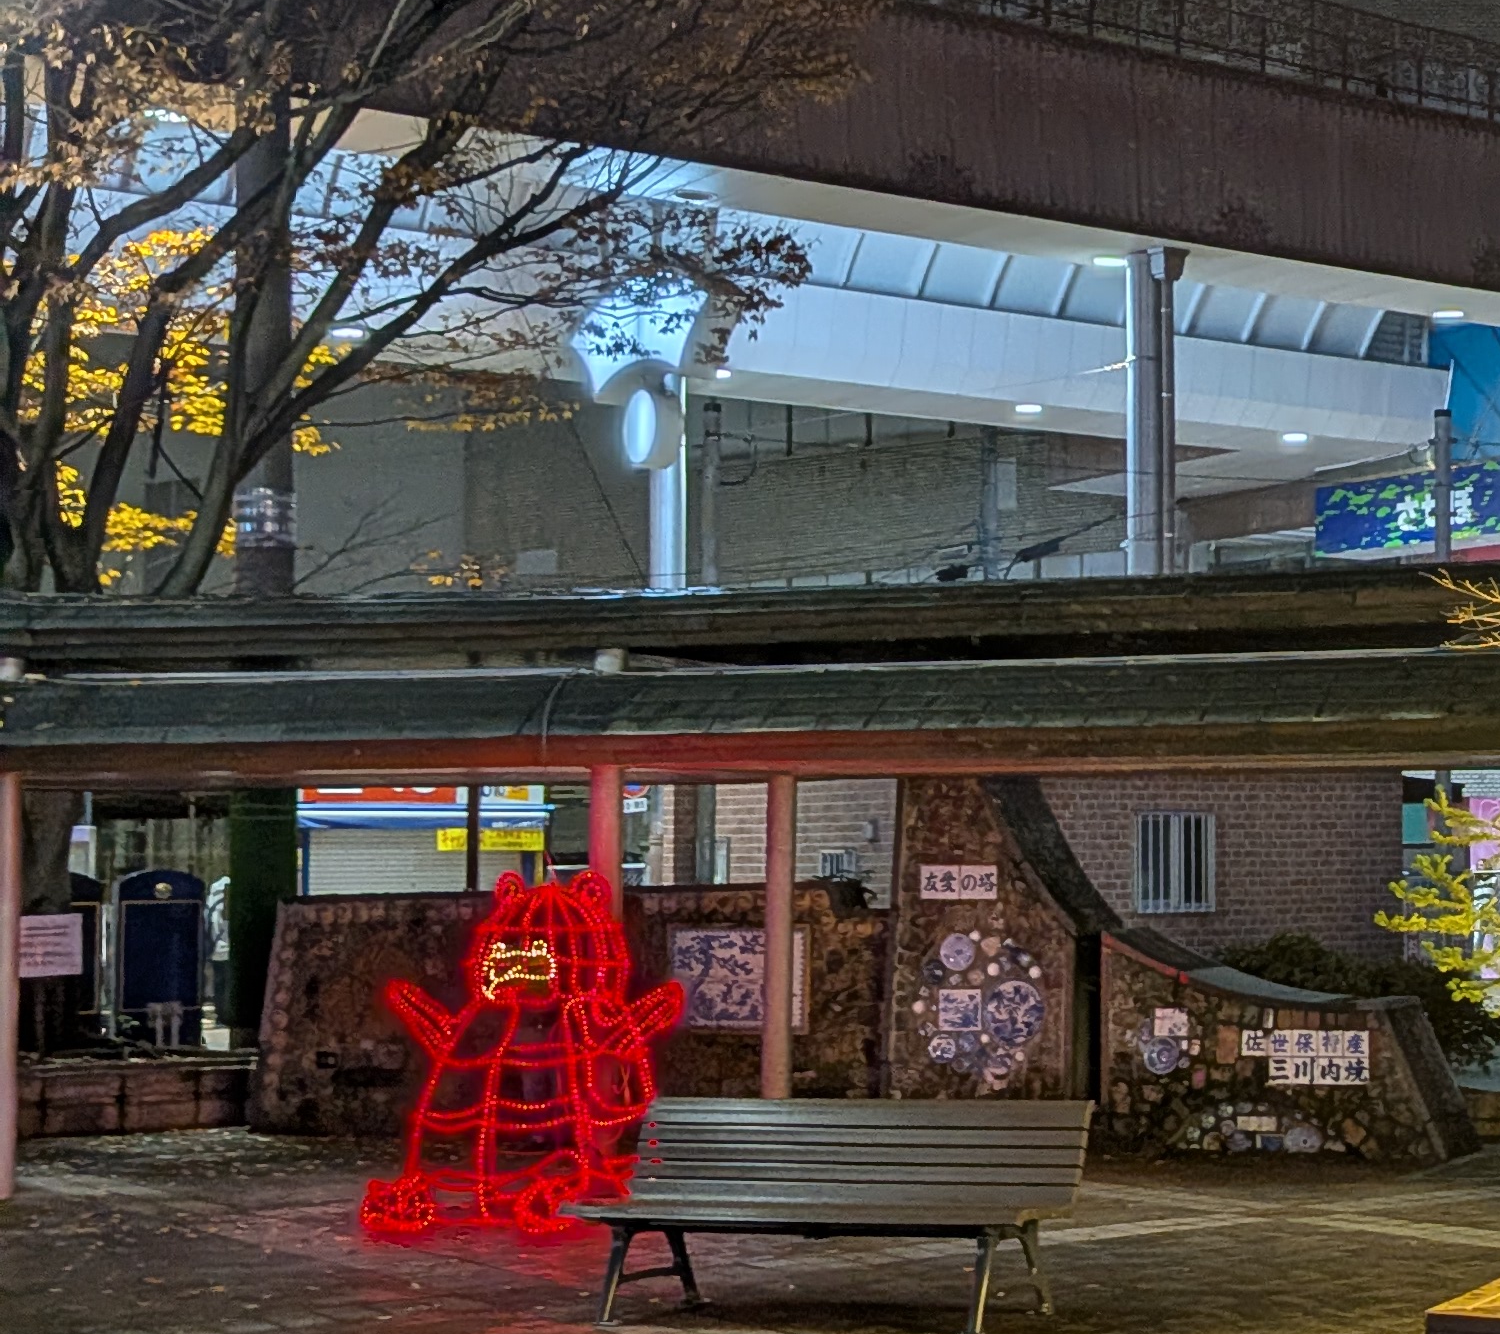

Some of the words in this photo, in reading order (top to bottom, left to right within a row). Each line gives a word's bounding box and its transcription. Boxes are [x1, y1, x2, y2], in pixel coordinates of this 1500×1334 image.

[923, 870, 997, 893] 友愛の塔
[1269, 1057, 1369, 1084] 三川内焼
